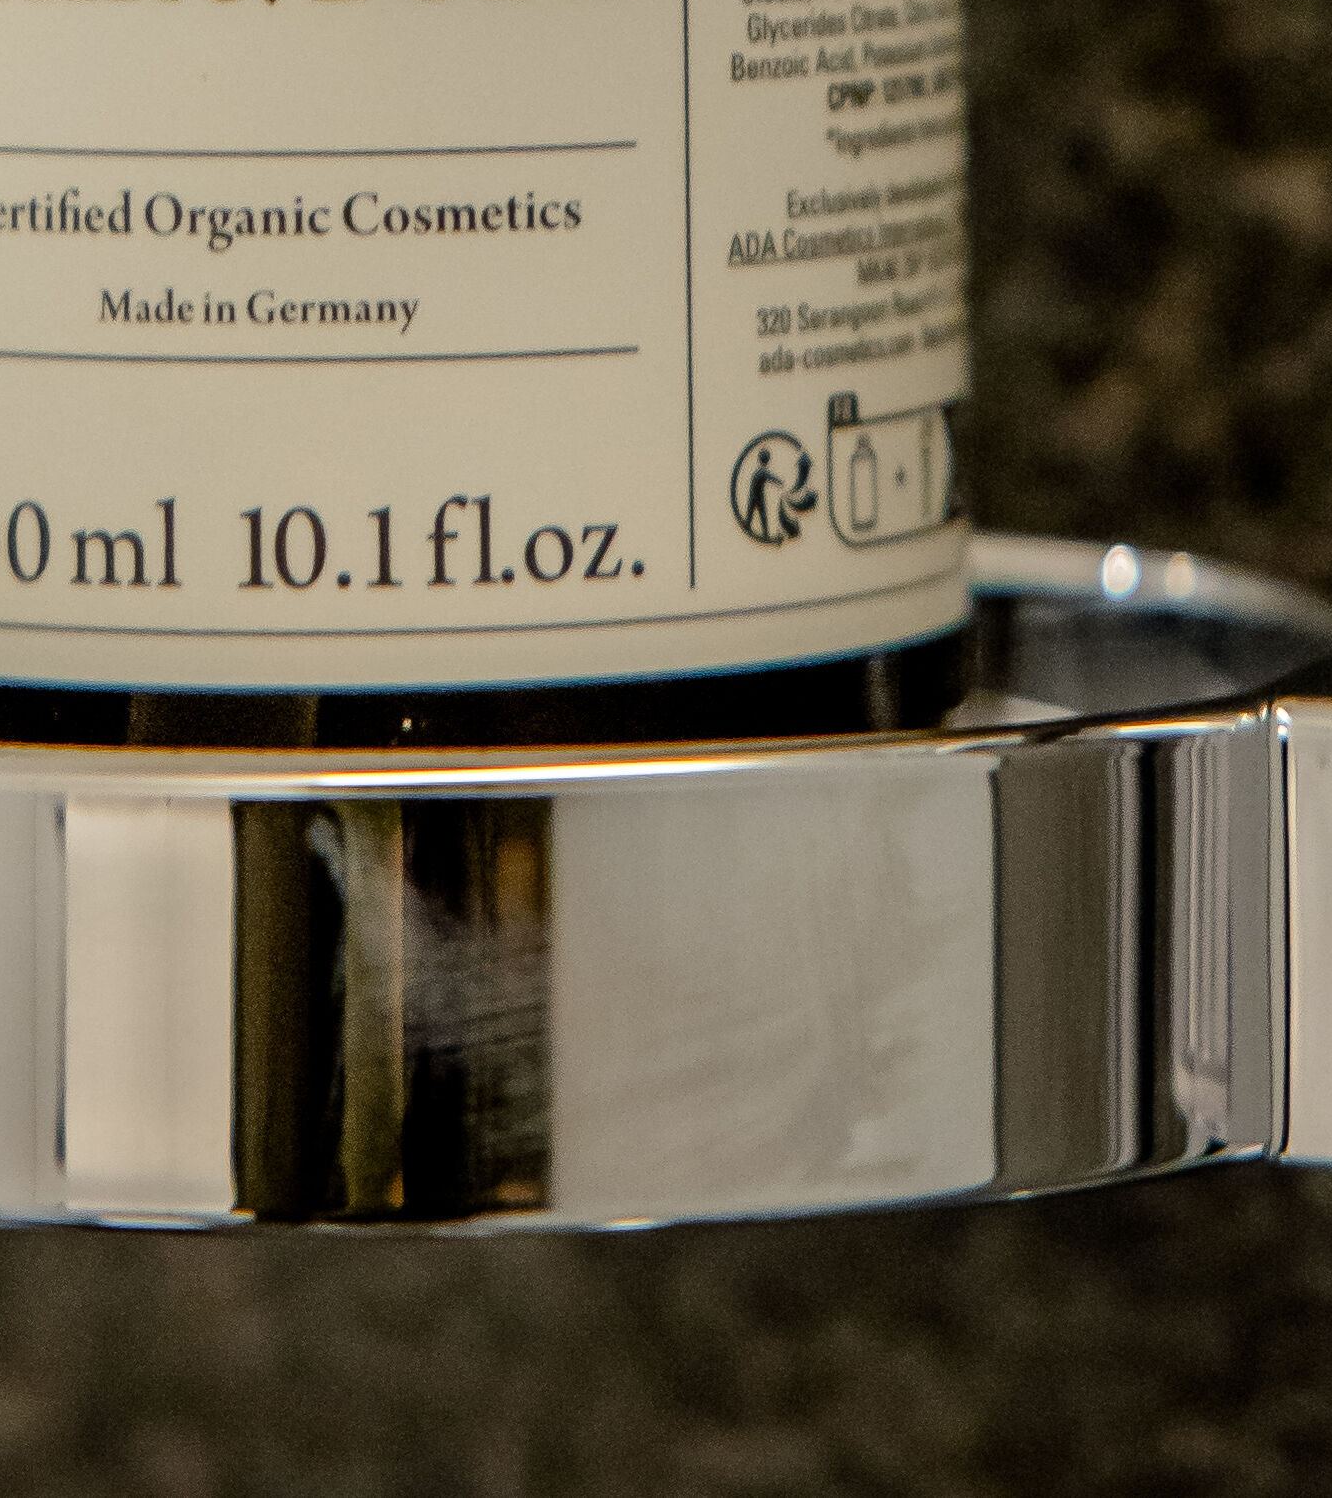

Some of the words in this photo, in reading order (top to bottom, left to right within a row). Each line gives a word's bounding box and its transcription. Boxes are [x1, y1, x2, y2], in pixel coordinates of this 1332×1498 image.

[730, 51, 810, 82] Benzoic
[144, 191, 329, 252] Organic
[342, 190, 582, 237] Cosmetics
[727, 231, 777, 267] ADA
[100, 287, 195, 323] Made
[203, 291, 237, 323] in
[246, 288, 419, 335] Germany
[70, 496, 181, 588] ml
[239, 505, 402, 591] 10.1
